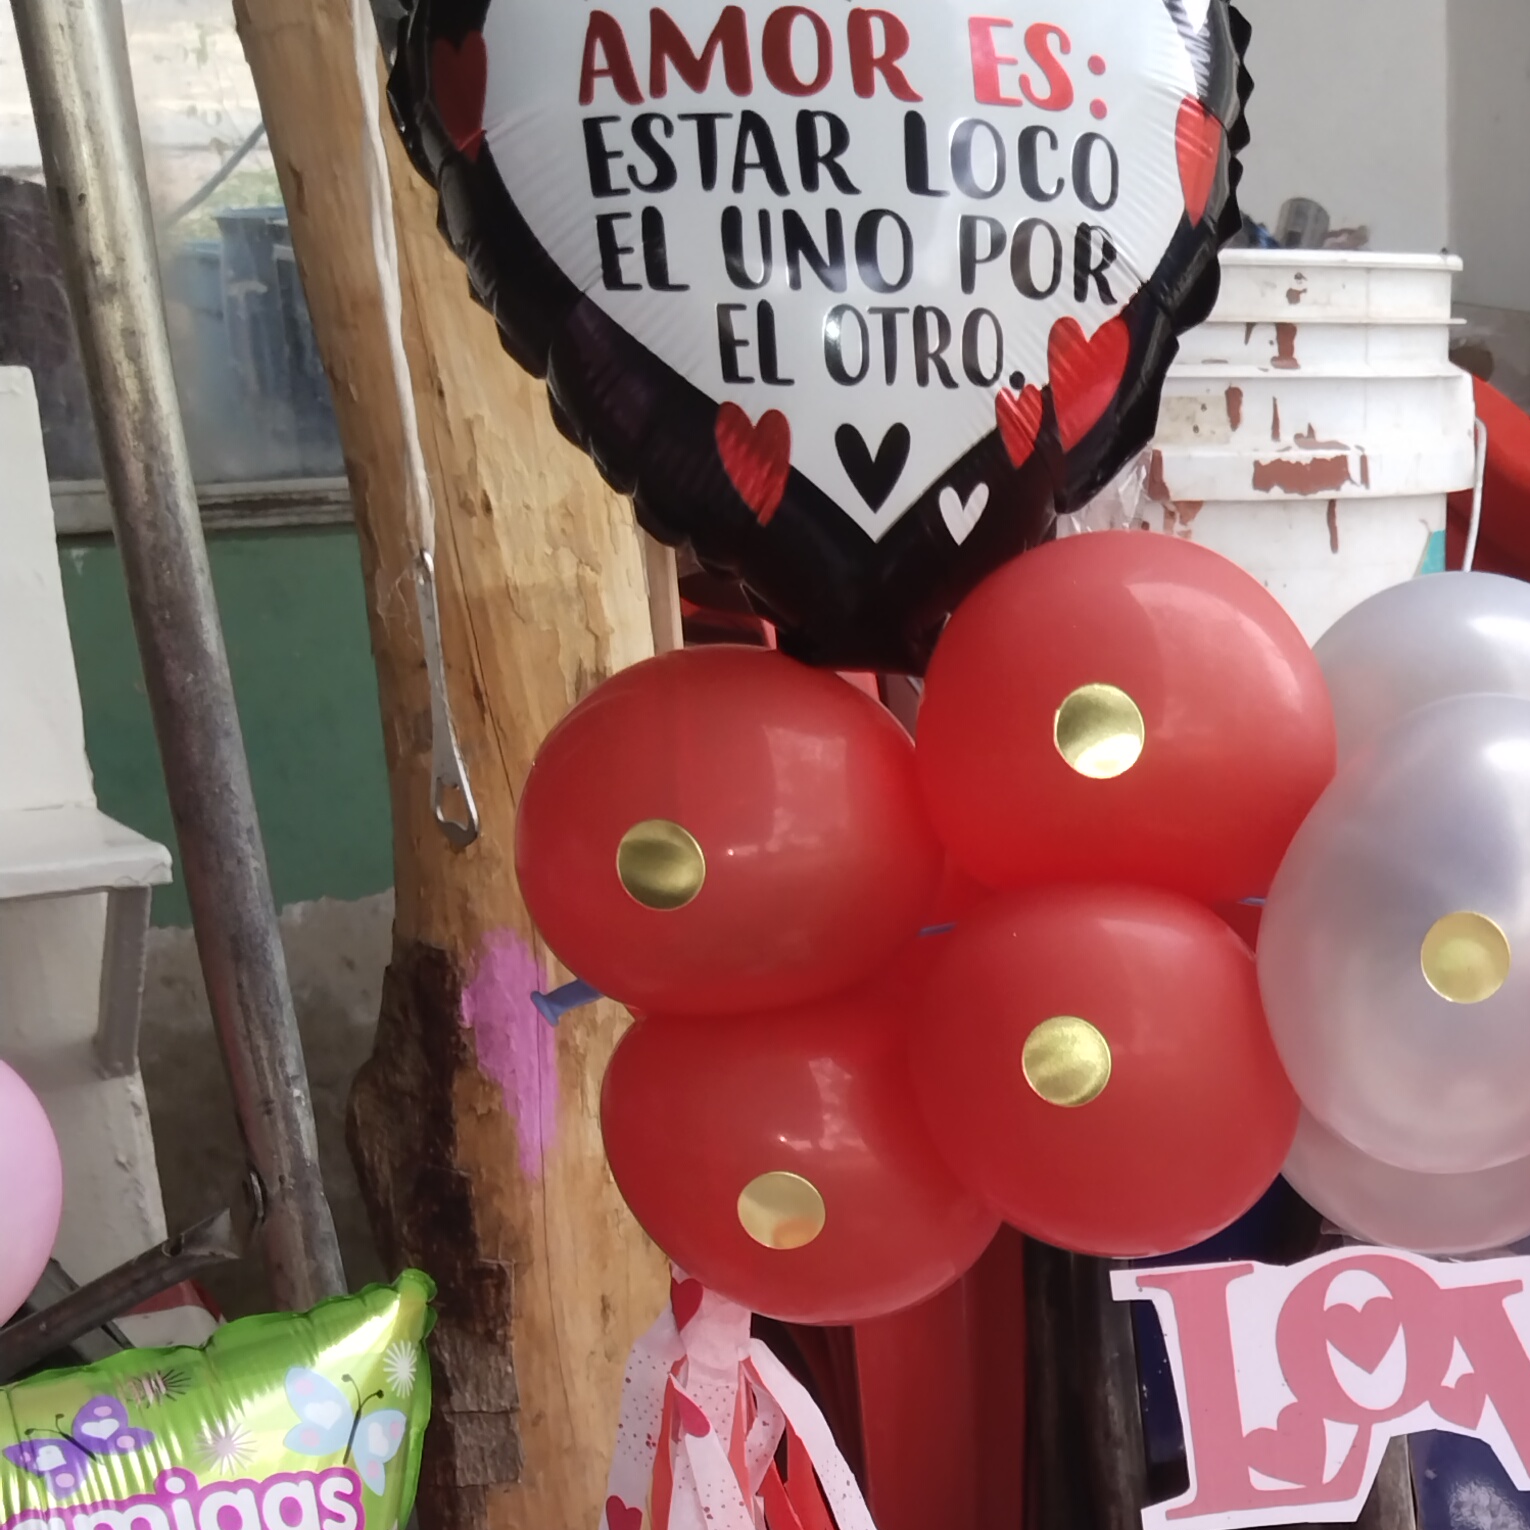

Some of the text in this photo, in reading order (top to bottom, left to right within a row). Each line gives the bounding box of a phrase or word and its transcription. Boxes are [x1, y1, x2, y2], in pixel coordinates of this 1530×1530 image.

[578, 4, 1108, 121] AMOR ES:
[582, 108, 1120, 212] ESTAR LOCO
[594, 204, 1118, 306] EL UNO POR
[715, 299, 1026, 390] EL OTRO.
